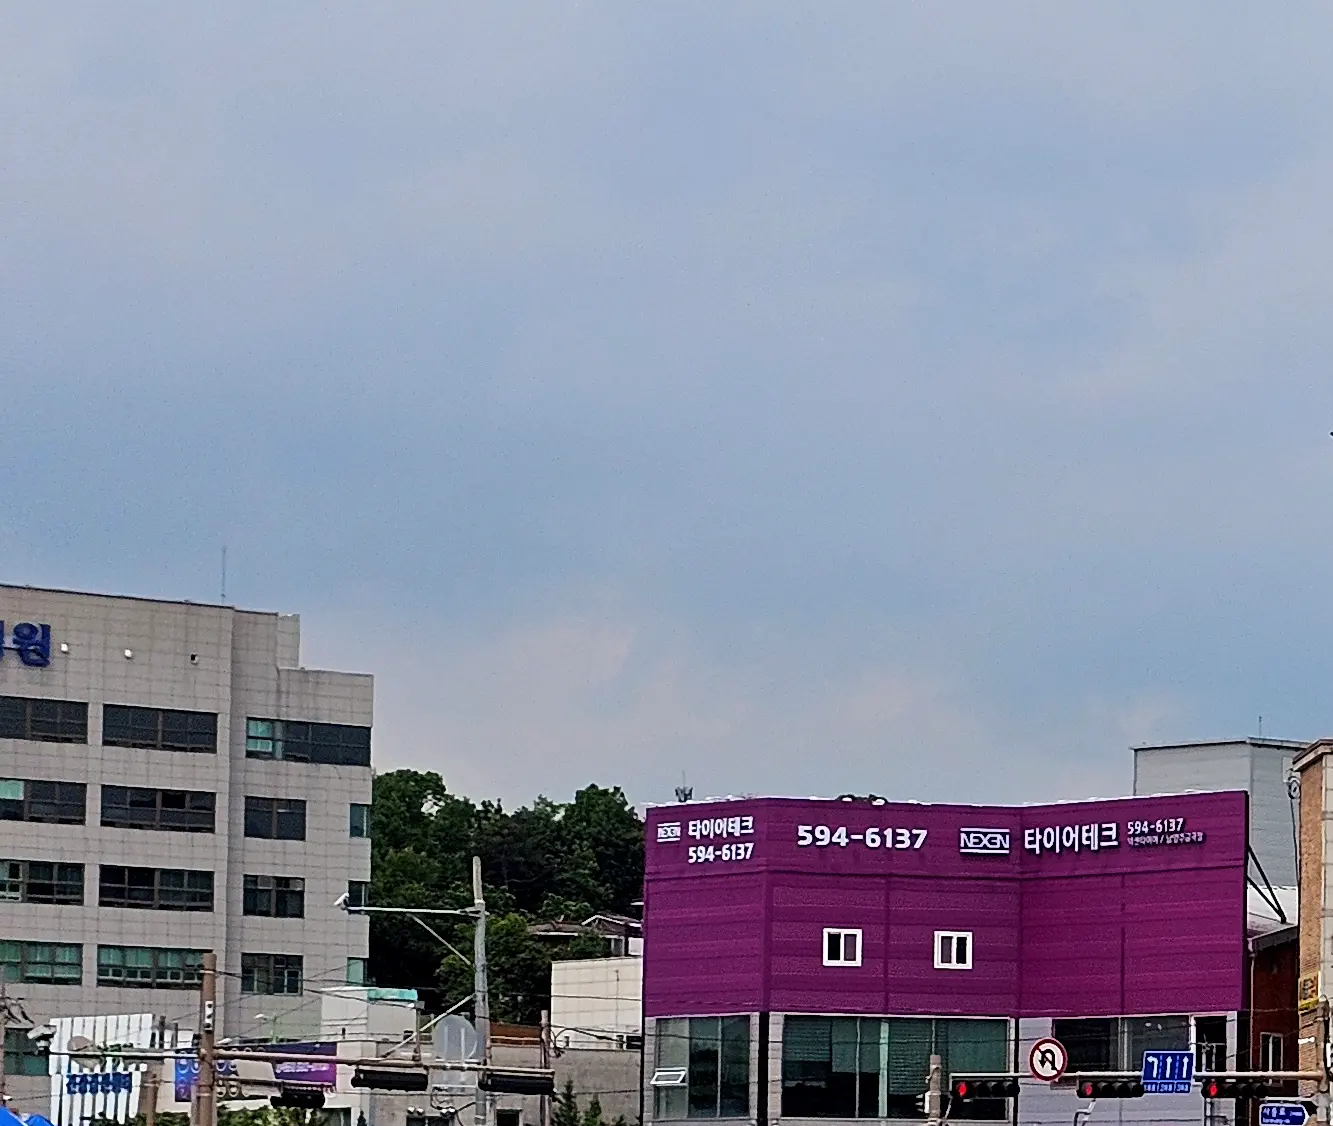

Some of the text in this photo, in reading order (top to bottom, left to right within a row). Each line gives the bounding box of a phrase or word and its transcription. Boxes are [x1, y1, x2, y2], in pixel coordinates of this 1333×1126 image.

[0, 620, 51, 667] 원
[688, 816, 754, 841] 타이어테크
[797, 825, 927, 849] 594-6137
[1024, 822, 1118, 854] 타이어테크
[1127, 818, 1184, 835] 594-6137
[960, 829, 1010, 852] NEXEN
[688, 843, 754, 863] 594-6137
